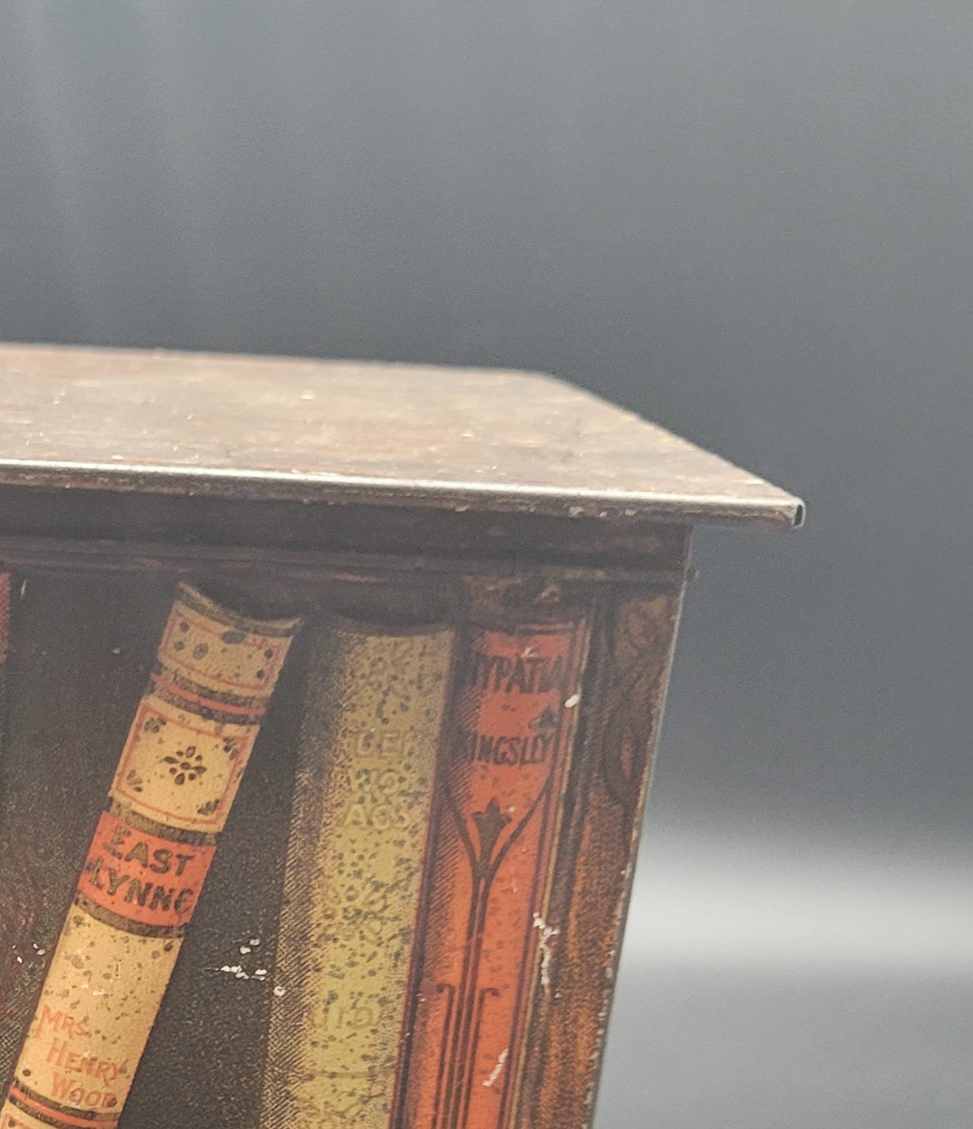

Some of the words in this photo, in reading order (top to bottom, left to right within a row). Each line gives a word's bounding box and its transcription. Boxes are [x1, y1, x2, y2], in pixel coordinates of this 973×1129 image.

[105, 823, 195, 878] EAST
[45, 1036, 129, 1088] HENRY
[50, 1071, 118, 1109] WOOD
